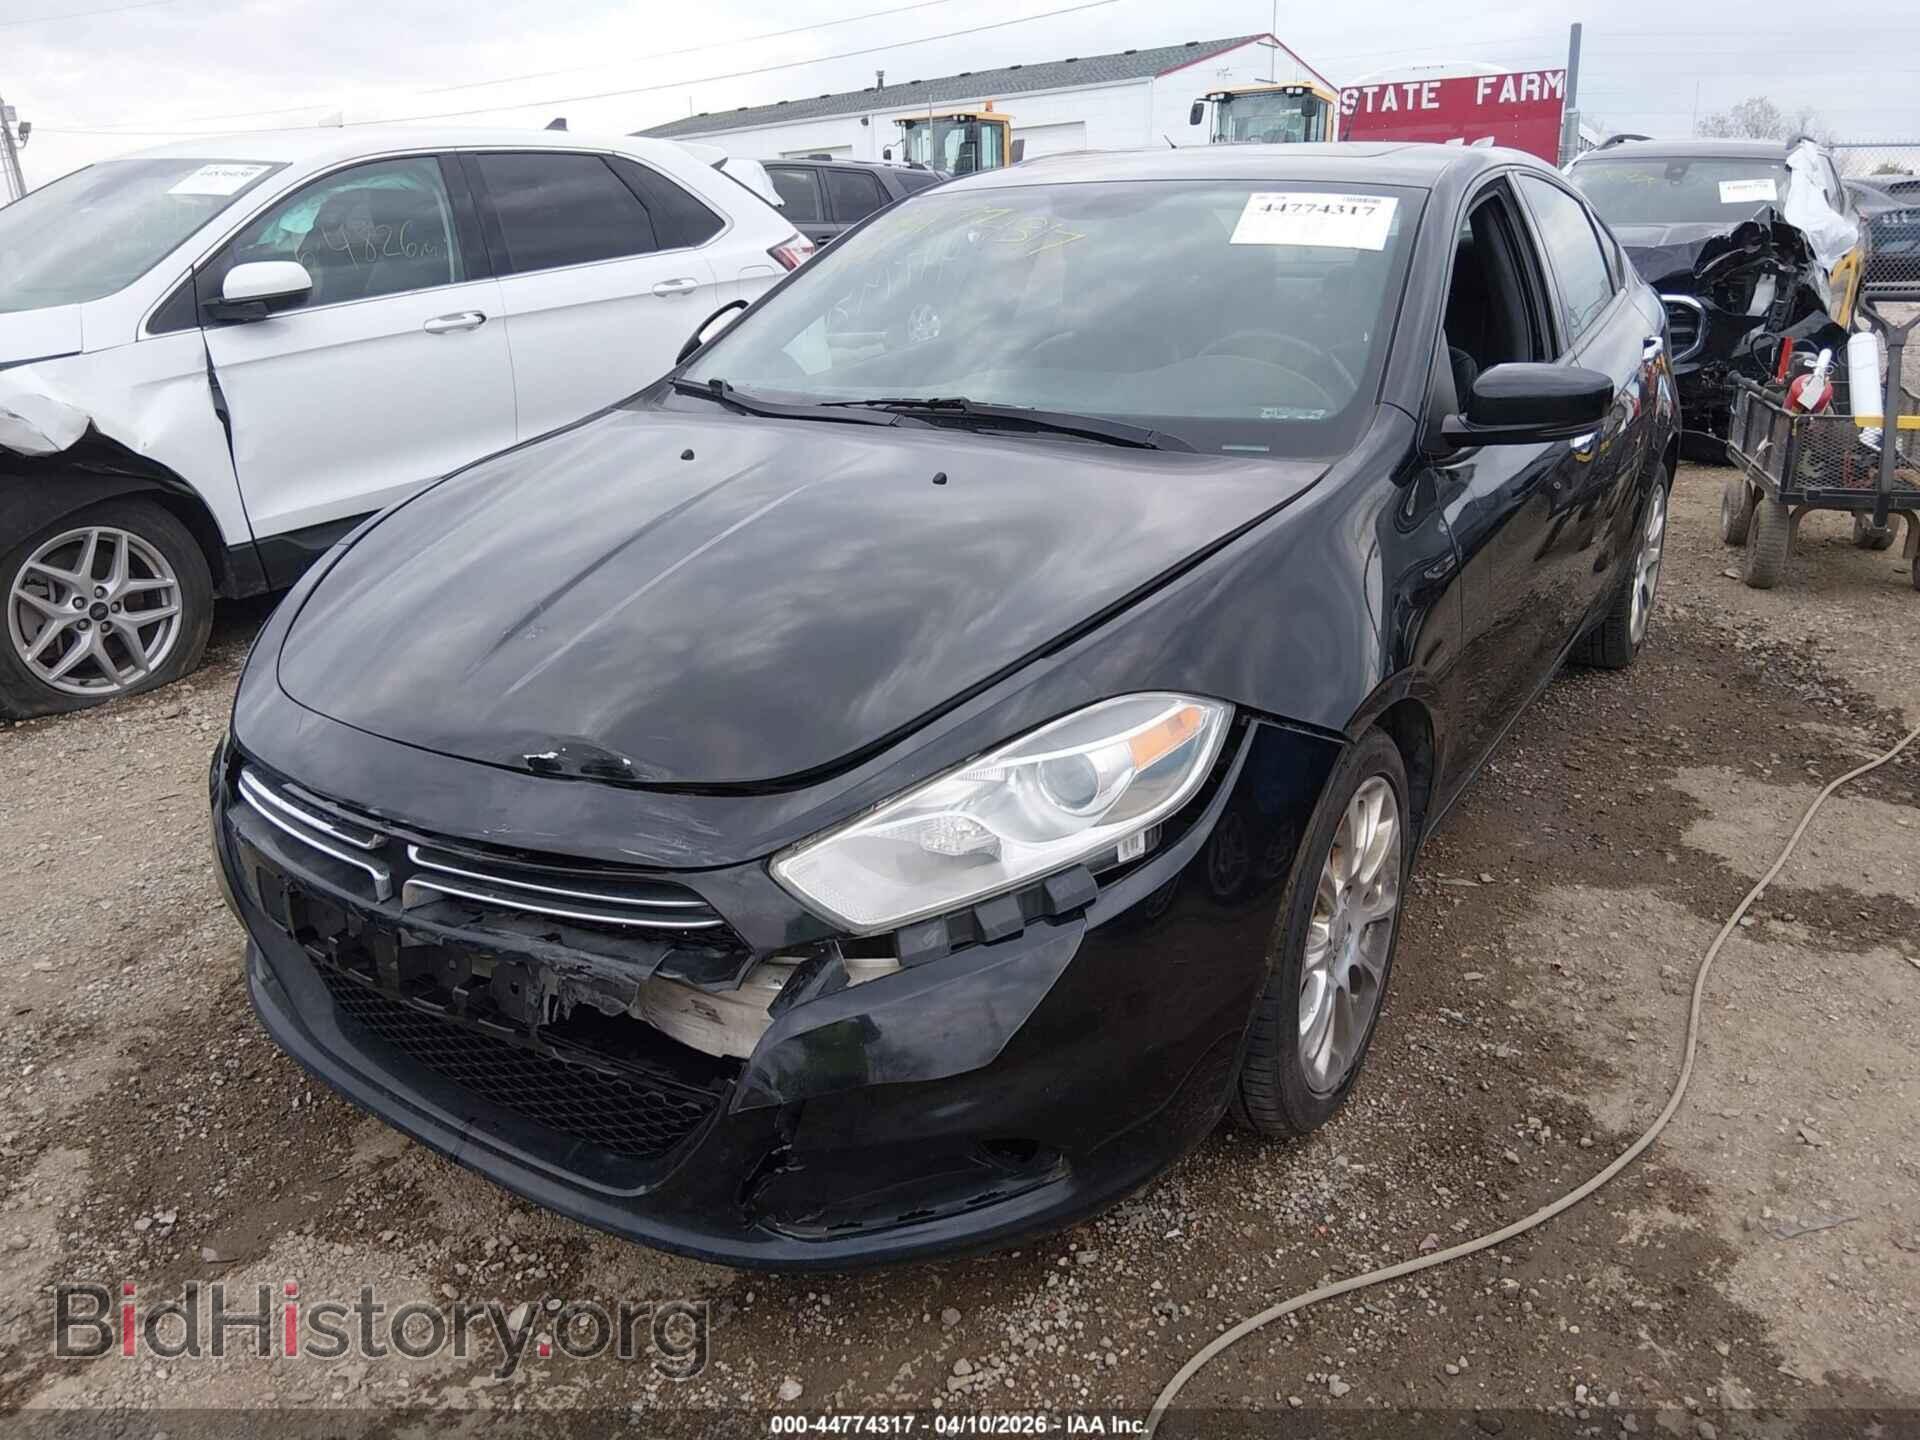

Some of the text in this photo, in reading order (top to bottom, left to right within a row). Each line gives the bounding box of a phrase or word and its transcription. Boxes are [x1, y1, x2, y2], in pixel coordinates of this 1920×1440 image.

[1341, 71, 1565, 116] STATE FARM
[1259, 202, 1377, 217] 44774317
